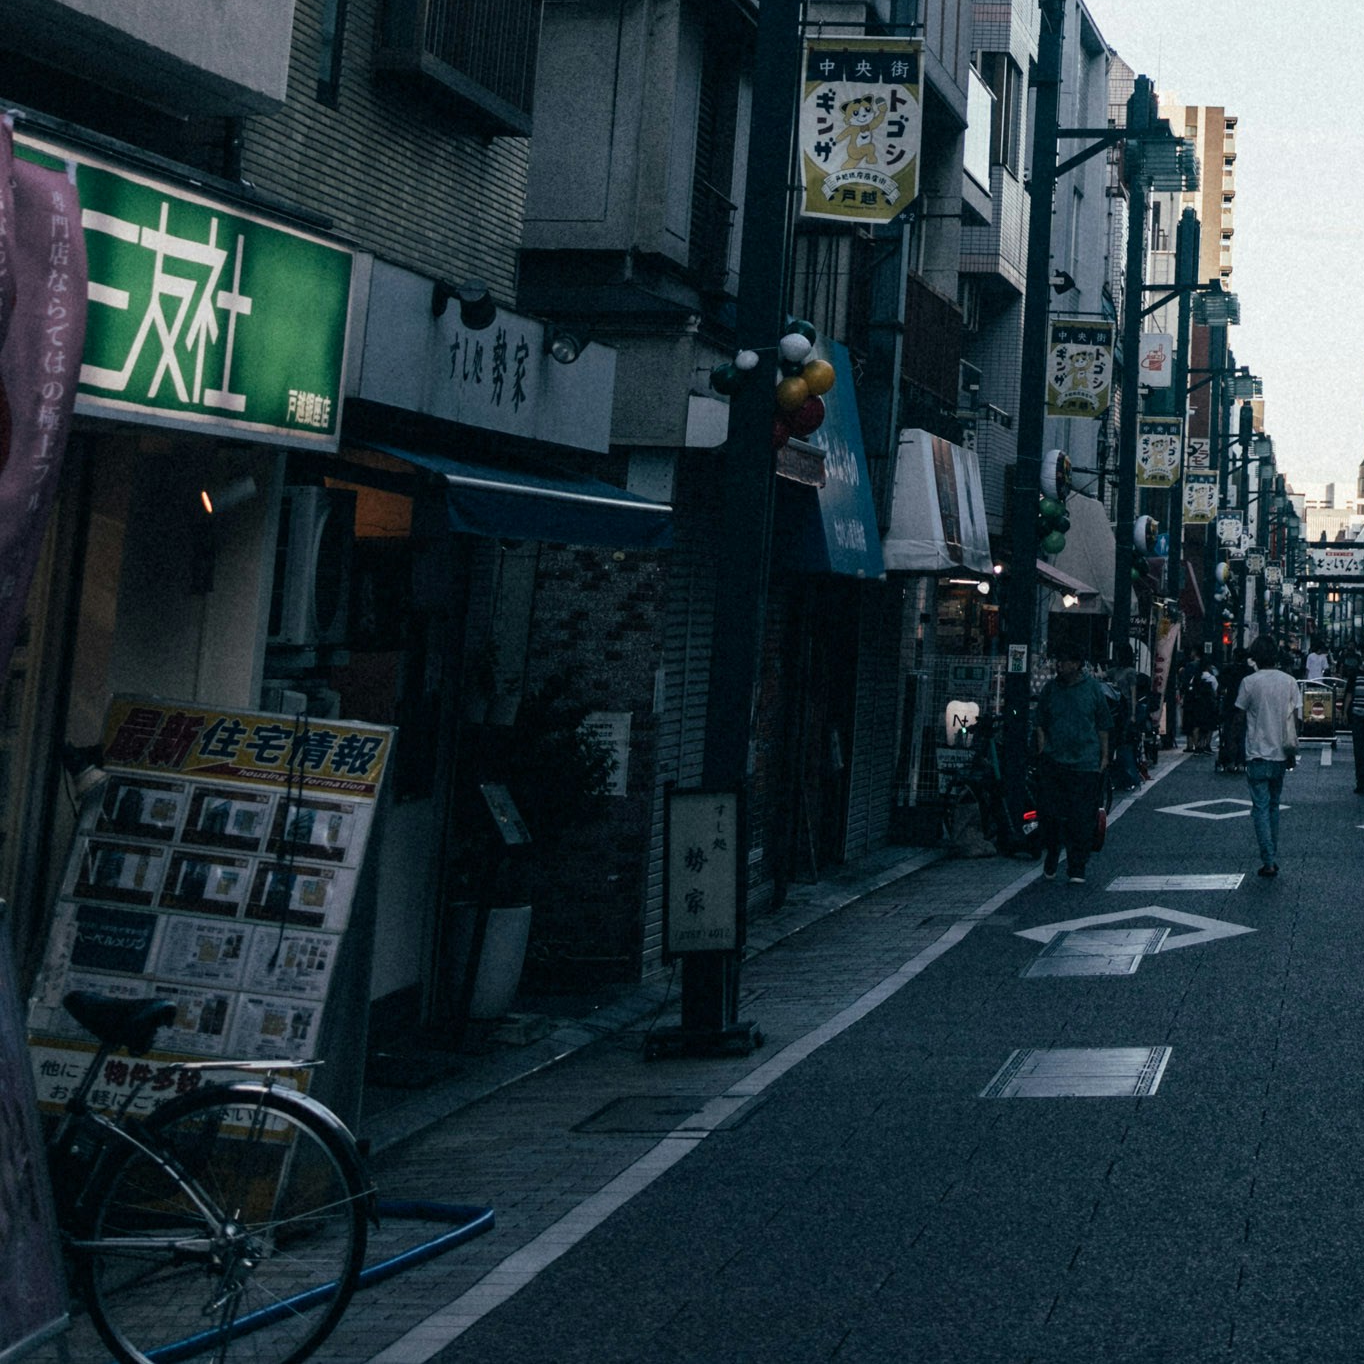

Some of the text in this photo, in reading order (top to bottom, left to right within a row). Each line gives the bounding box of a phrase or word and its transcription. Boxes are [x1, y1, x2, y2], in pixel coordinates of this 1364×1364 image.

[819, 58, 910, 79] 中央街
[814, 88, 838, 163] ギンザ
[886, 89, 910, 166] トゴシ
[841, 188, 878, 205] 戸越
[1057, 330, 1108, 343] 中央街
[1054, 346, 1069, 387] ギンザ
[1092, 348, 1107, 389] トゴシ
[101, 707, 383, 776] 最新住宅情報
[237, 768, 286, 782] housing
[712, 804, 727, 851] すし処
[684, 847, 708, 915] 勢家
